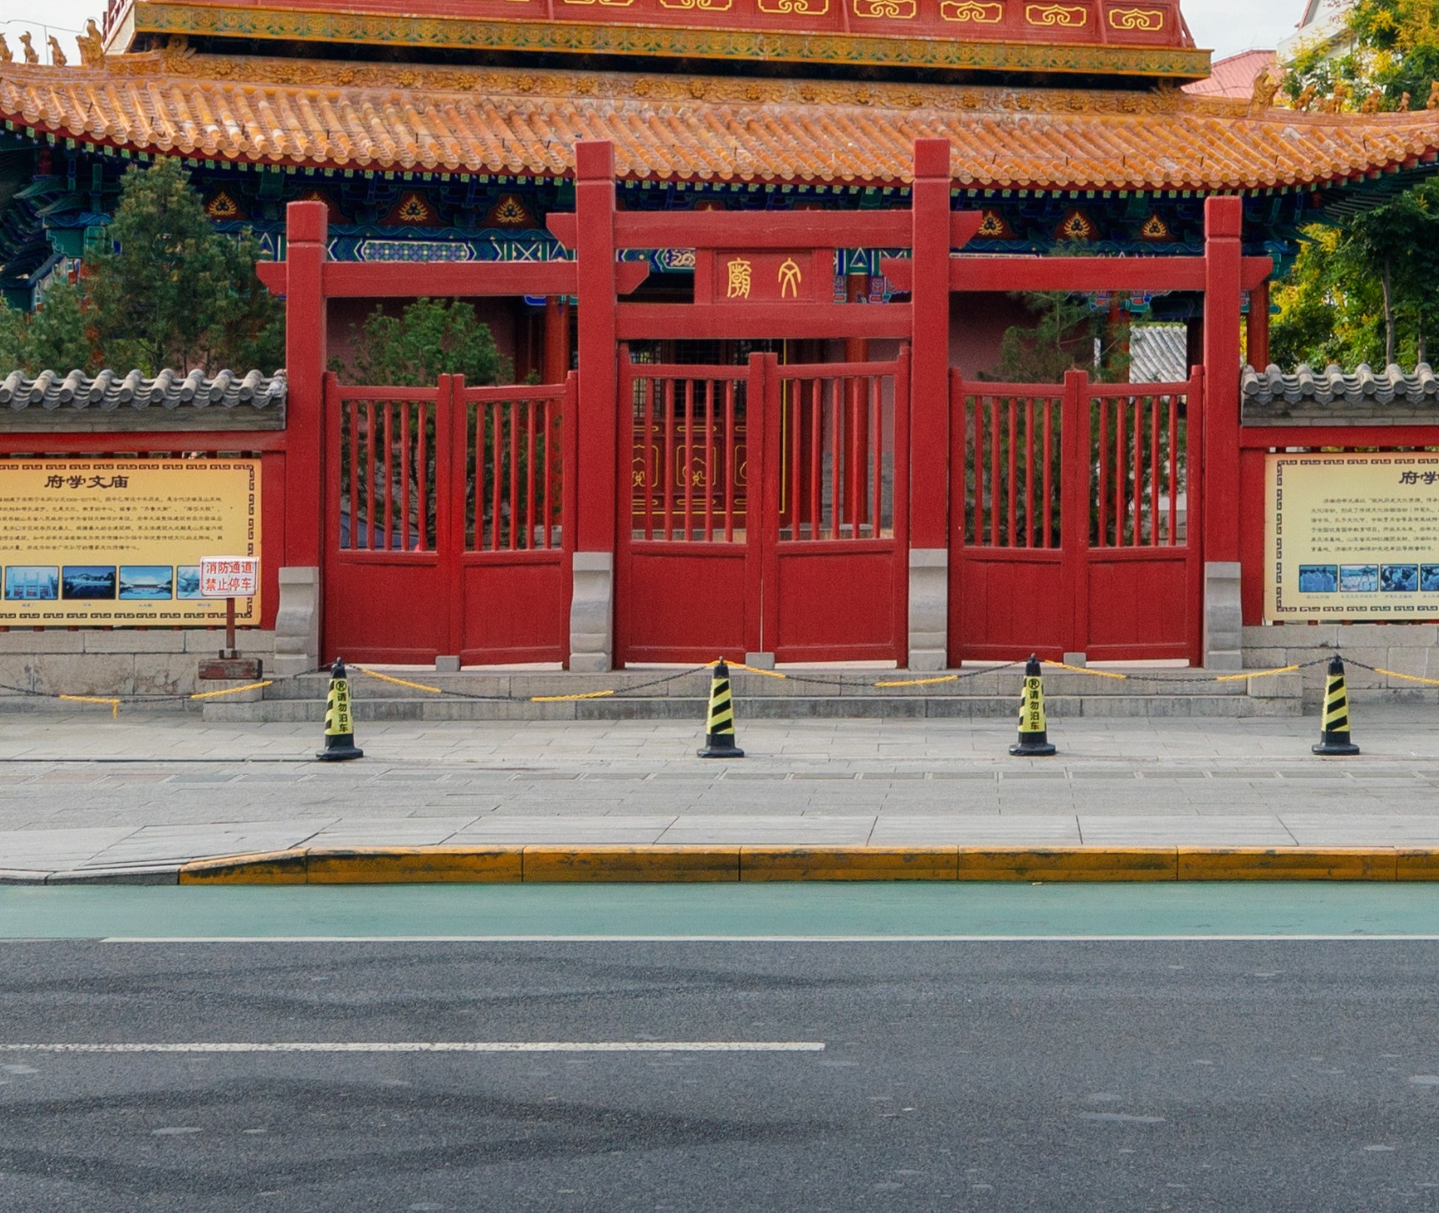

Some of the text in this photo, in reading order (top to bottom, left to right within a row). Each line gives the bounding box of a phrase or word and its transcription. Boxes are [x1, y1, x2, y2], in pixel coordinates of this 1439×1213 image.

[43, 474, 130, 489] 府学文庙
[206, 561, 253, 574] 消防通道
[205, 577, 252, 591] 禁止停车
[337, 692, 349, 733] 请勿泊车
[1029, 690, 1040, 731] 请勿泊车
